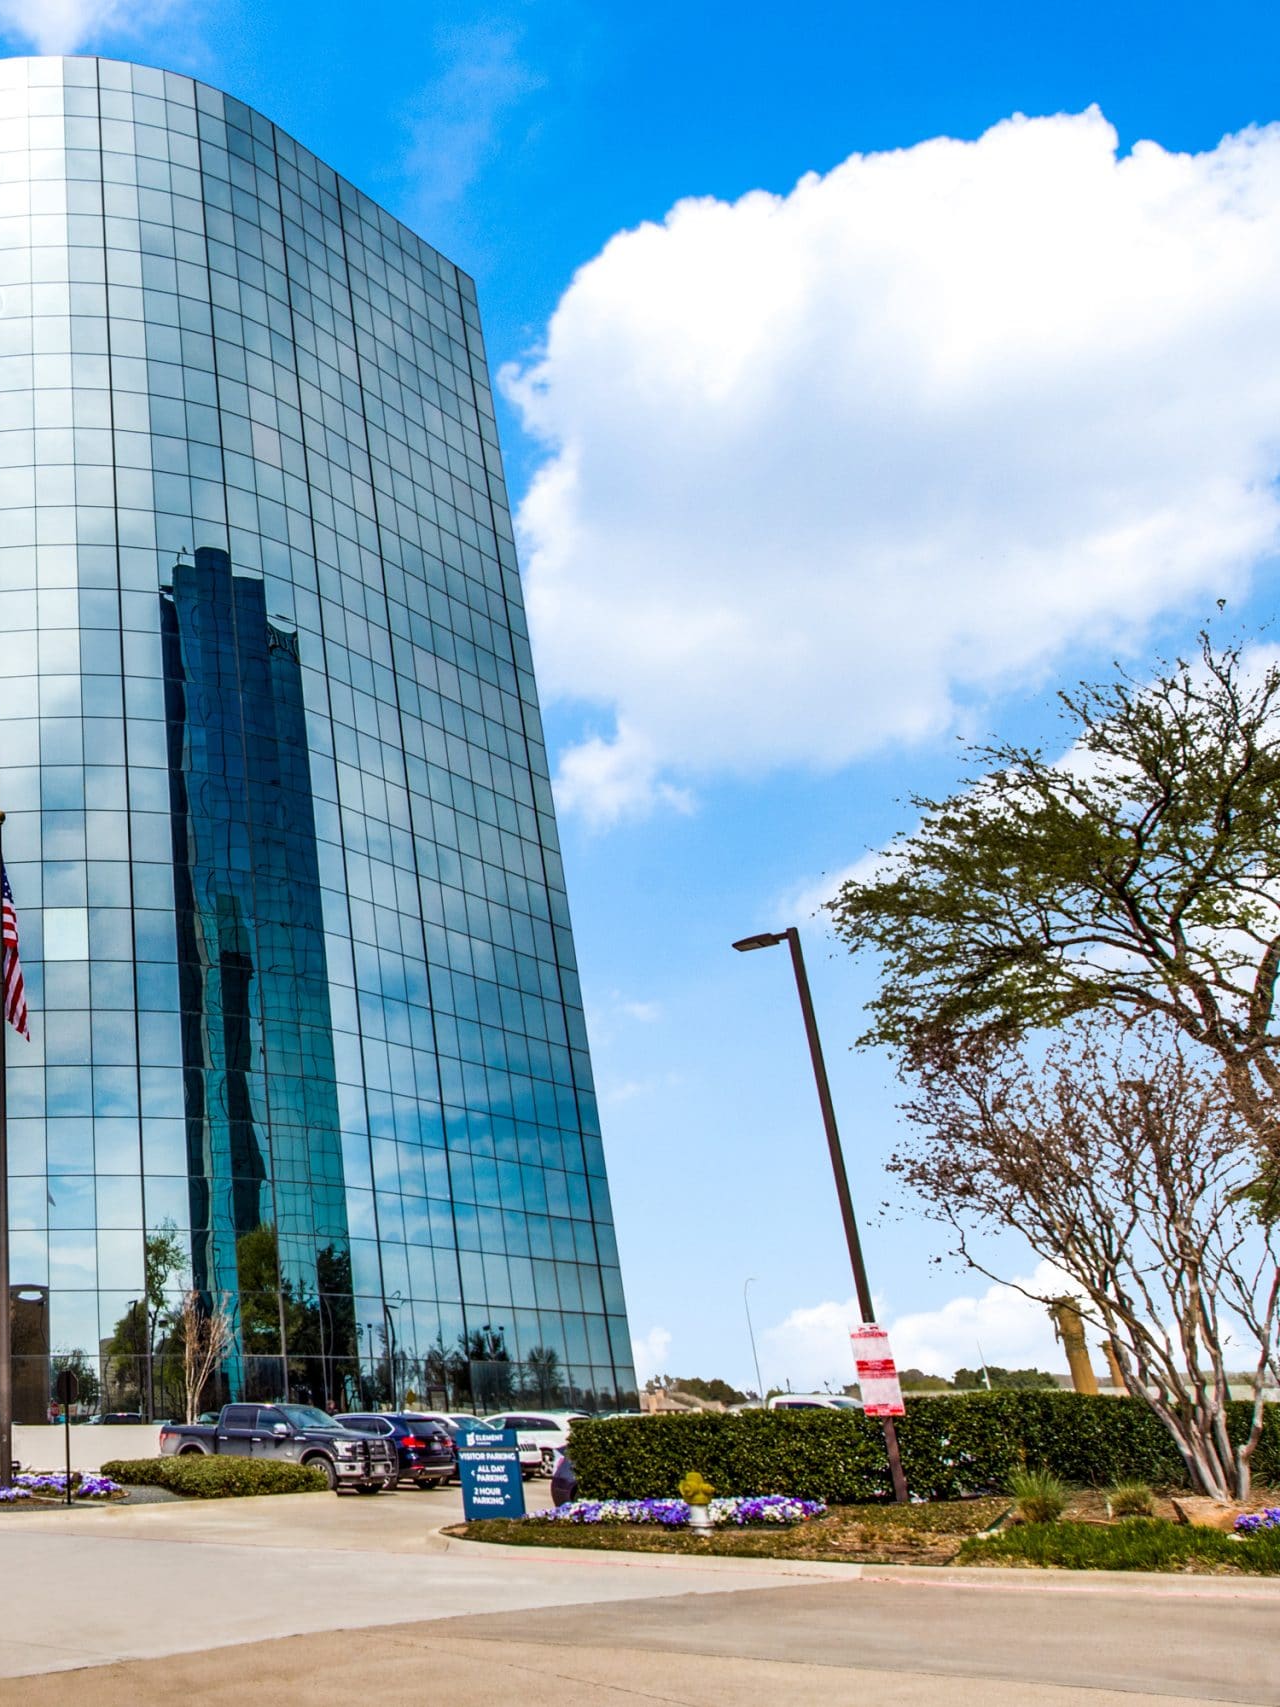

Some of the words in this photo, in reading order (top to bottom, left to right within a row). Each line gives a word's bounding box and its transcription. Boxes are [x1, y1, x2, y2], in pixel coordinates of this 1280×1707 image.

[459, 1452, 485, 1460] VISITOR
[486, 1452, 516, 1461] PARKING
[490, 1465, 505, 1473] DAY
[476, 1474, 509, 1482] PARKING
[473, 1487, 479, 1495] 2
[479, 1487, 501, 1495] HOUR
[472, 1496, 505, 1505] PARKING
